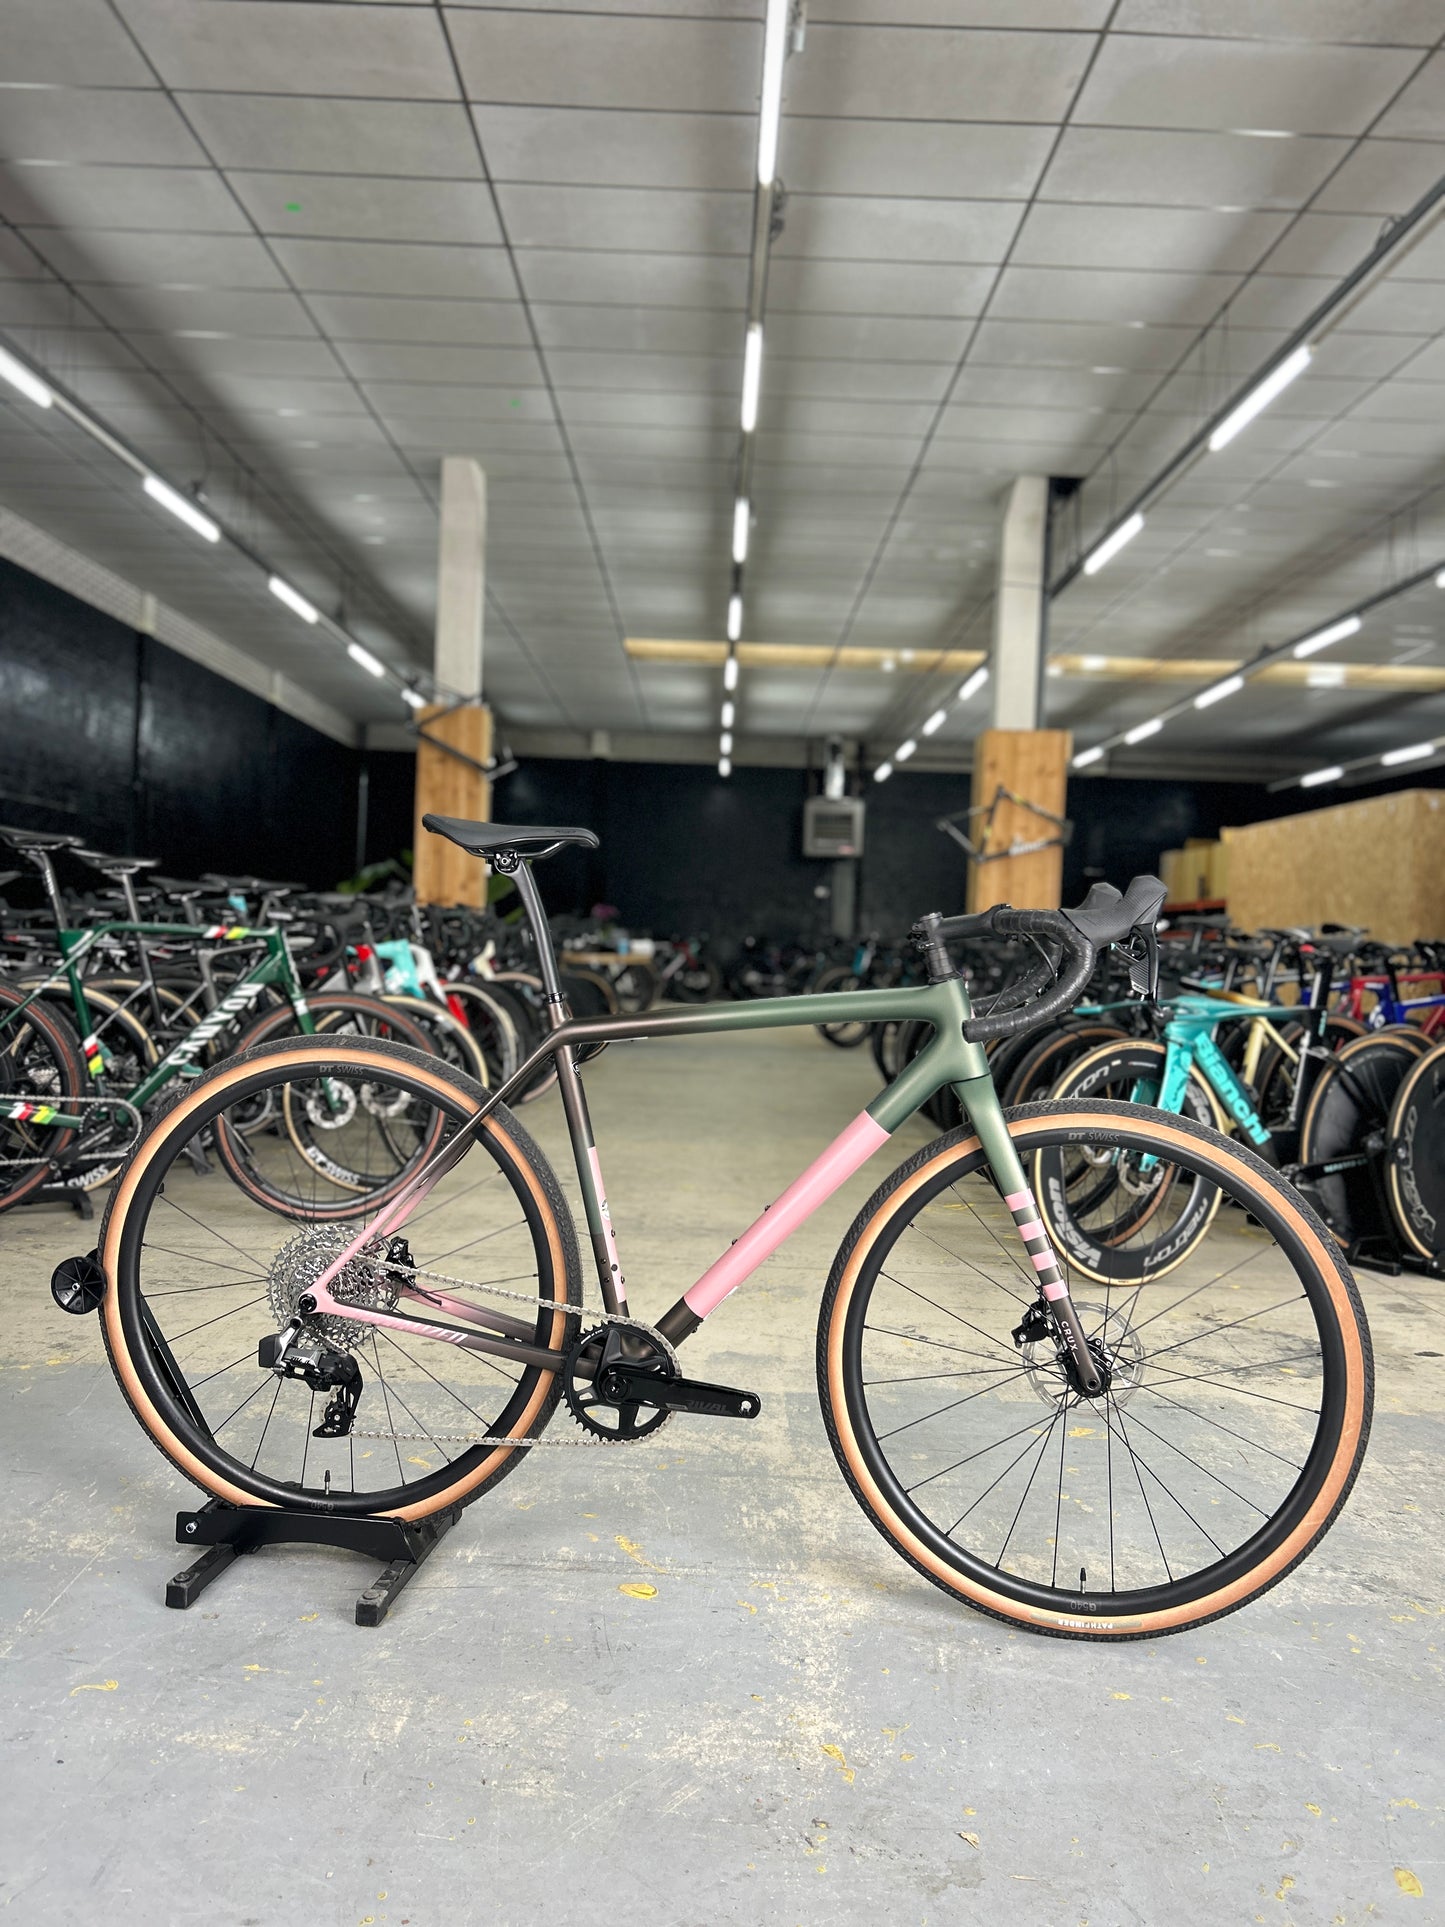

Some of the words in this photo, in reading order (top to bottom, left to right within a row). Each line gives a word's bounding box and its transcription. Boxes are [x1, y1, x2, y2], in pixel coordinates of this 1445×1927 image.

[166, 983, 264, 1066] CANYON
[319, 1064, 334, 1073] DT
[336, 1064, 364, 1075] SWISS
[1194, 1031, 1272, 1145] Bianchi
[1068, 1132, 1085, 1141] DT
[1088, 1132, 1120, 1143] SWISS
[1060, 1320, 1079, 1352] CRUX
[1070, 1600, 1097, 1612] G540
[1056, 1618, 1114, 1630] PATHFINDER
